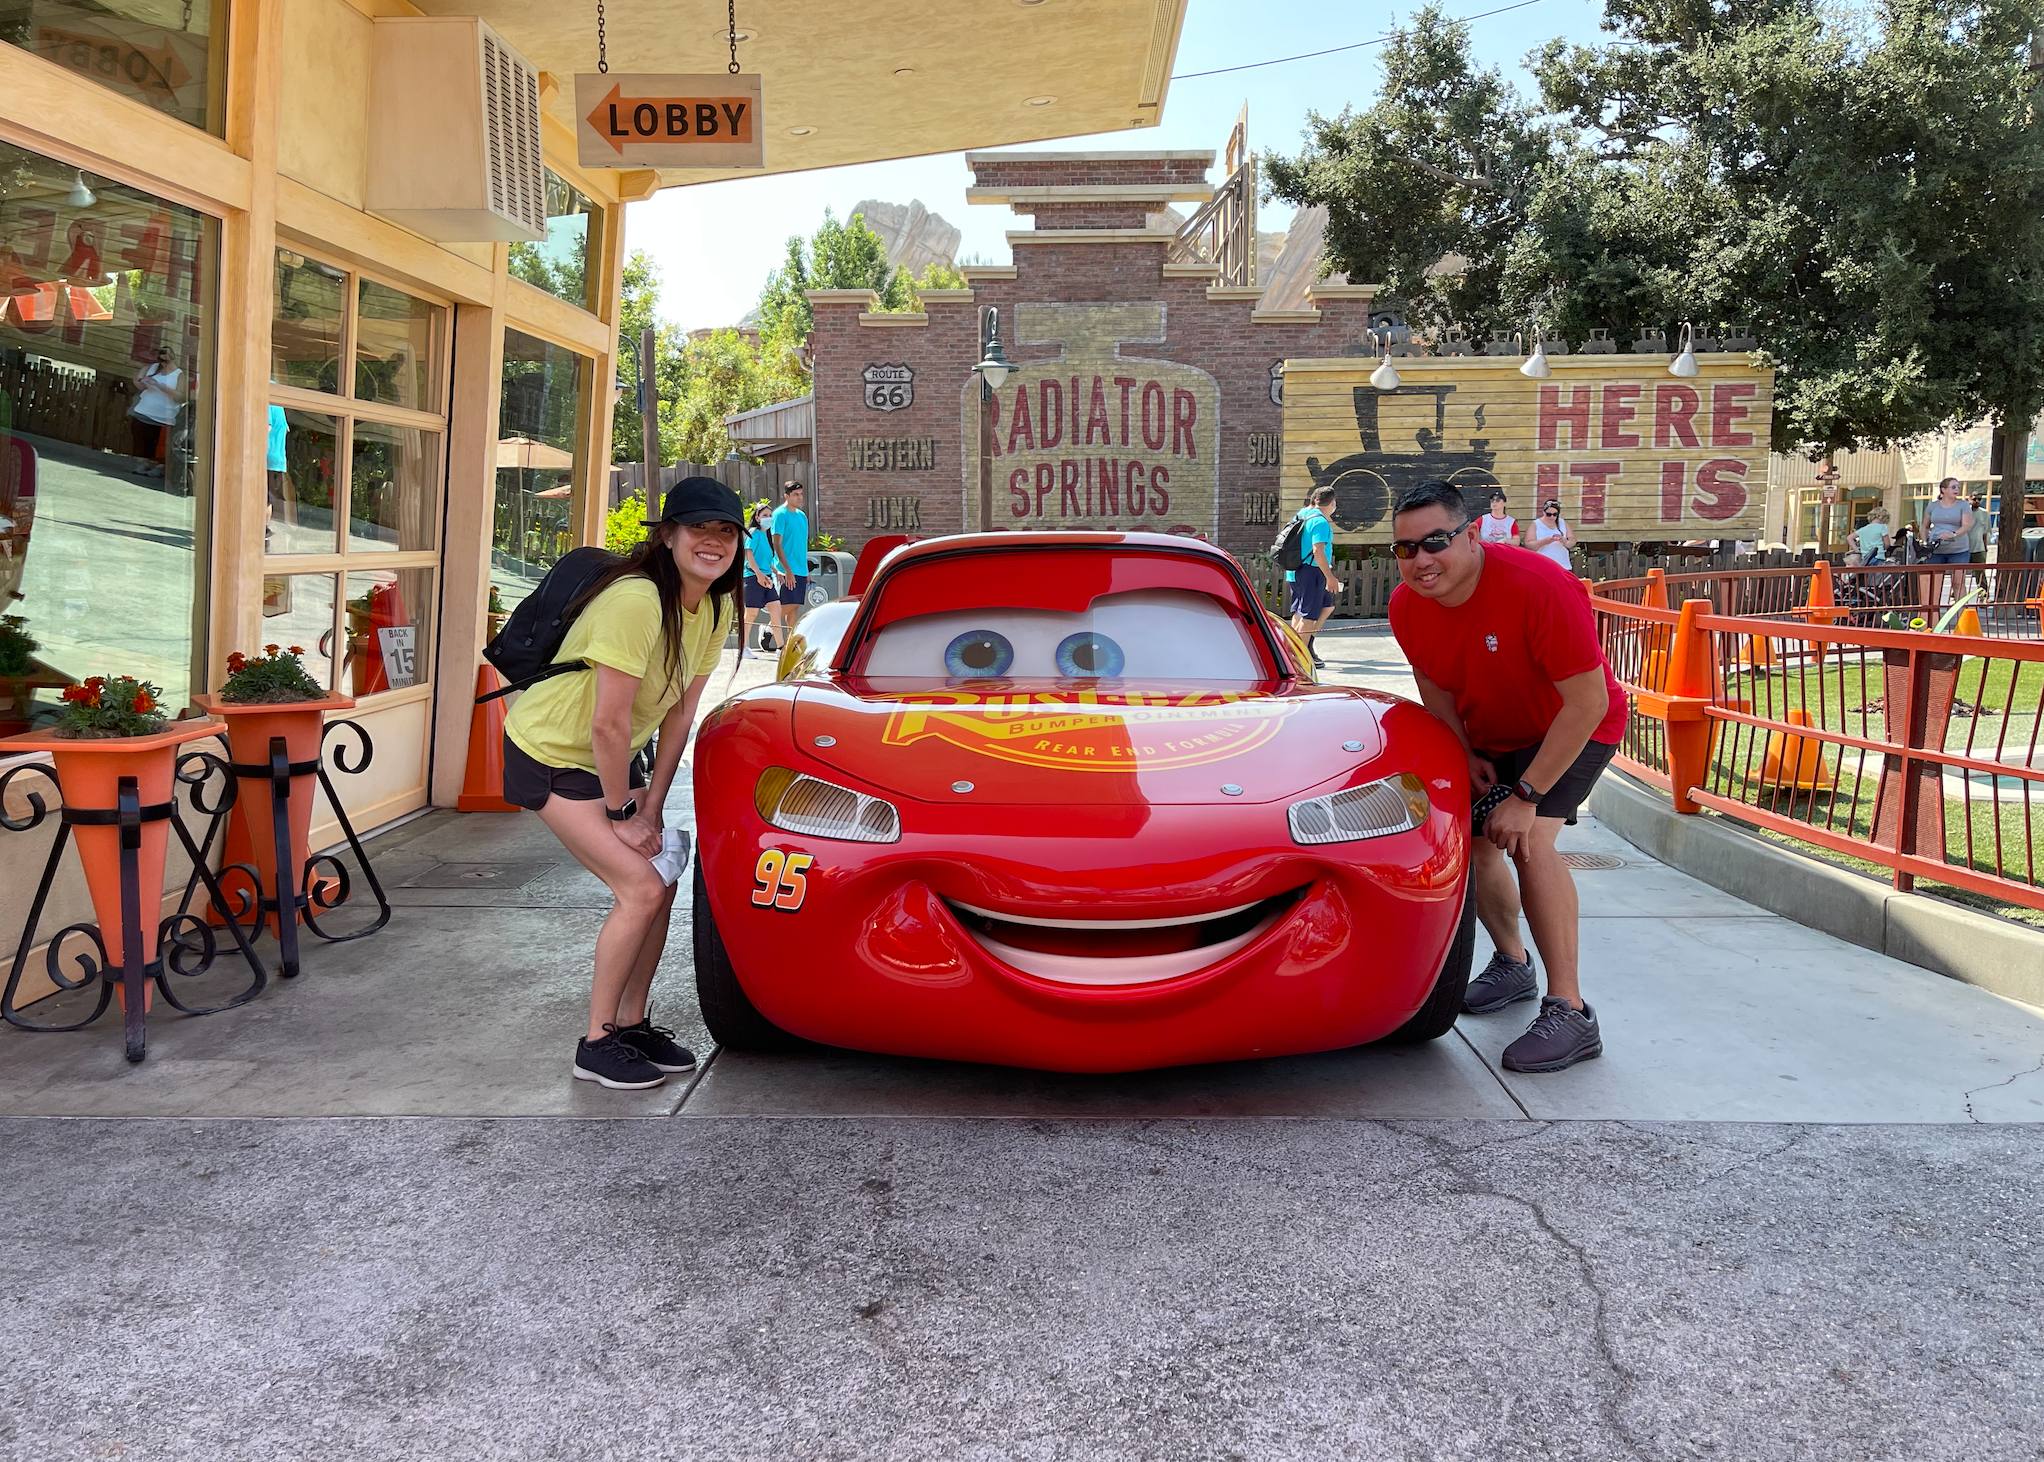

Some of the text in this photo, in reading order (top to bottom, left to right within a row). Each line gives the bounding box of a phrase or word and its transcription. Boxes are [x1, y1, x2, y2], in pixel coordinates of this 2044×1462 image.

[609, 103, 746, 137] LOBBY
[872, 370, 905, 379] ROUTE
[872, 385, 905, 407] 66
[1538, 383, 1757, 450] HERE
[847, 437, 934, 470] WESTERN
[1248, 433, 1282, 466] SOU
[1009, 458, 1170, 518] SPRINGS
[1536, 458, 1748, 524] IT IS
[864, 496, 921, 529] JUNK
[1243, 492, 1280, 526] BRIC
[388, 629, 408, 638] BACK
[396, 638, 404, 647] IN
[390, 648, 414, 674] 15
[751, 847, 815, 912] 95
